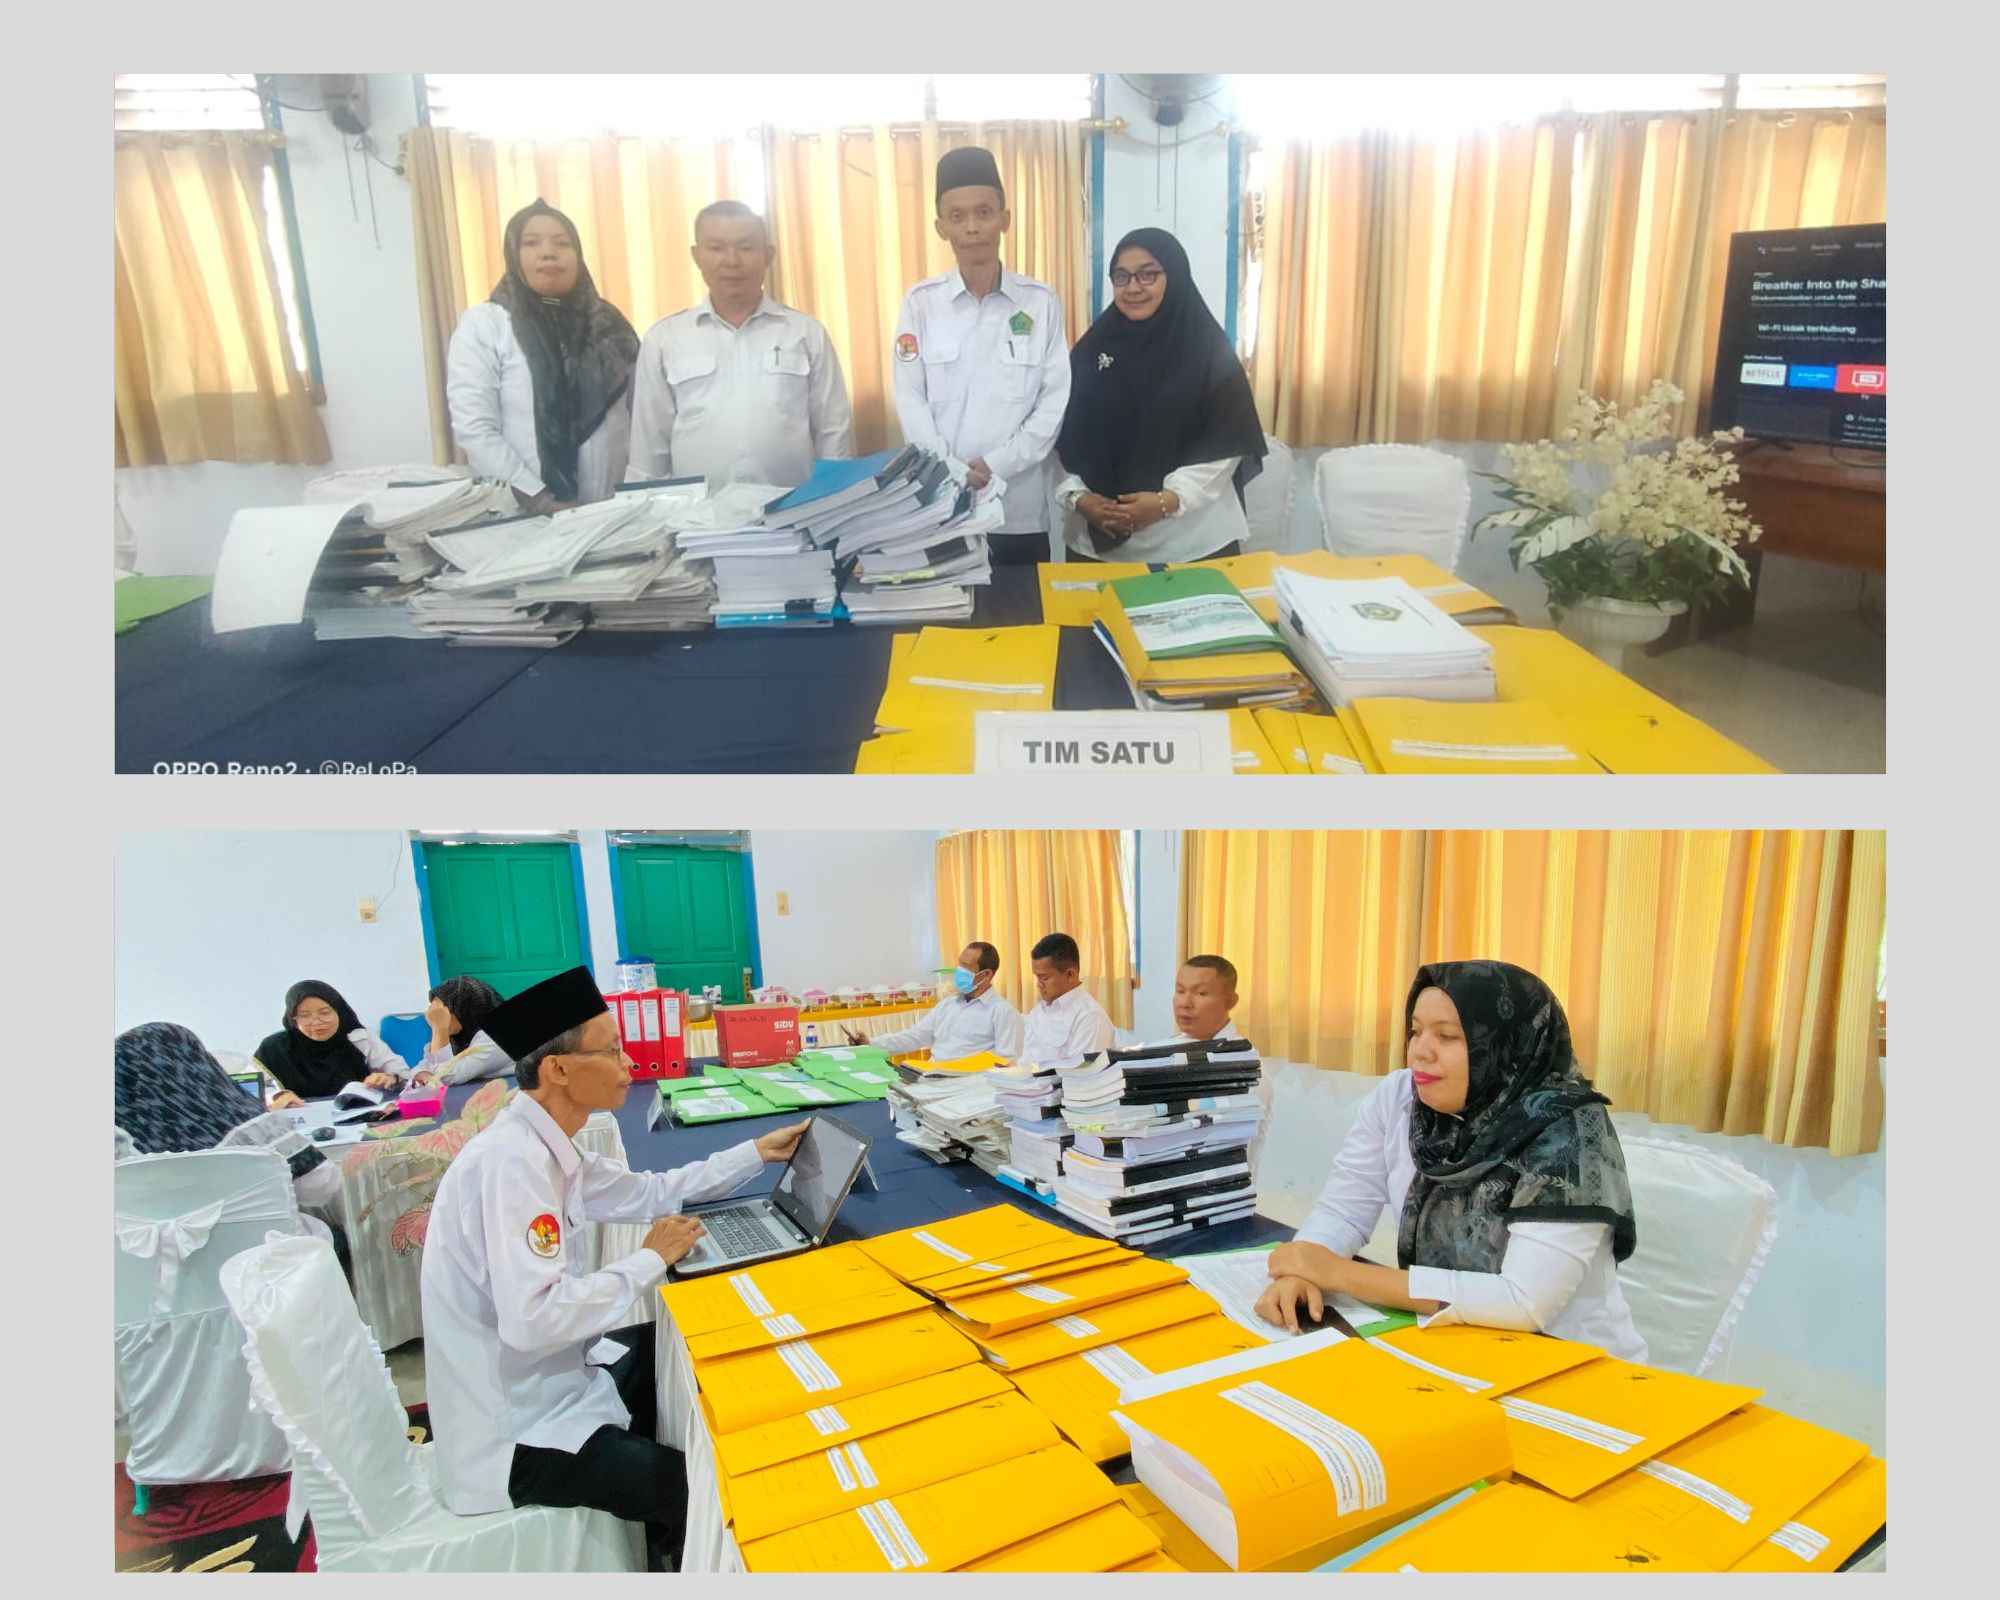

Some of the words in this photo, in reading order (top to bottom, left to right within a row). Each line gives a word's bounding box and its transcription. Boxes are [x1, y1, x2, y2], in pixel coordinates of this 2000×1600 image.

[1753, 280, 1803, 290] Breathe:
[1807, 280, 1832, 290] Into
[1835, 279, 1858, 289] the
[1023, 741, 1079, 764] TIM
[1091, 741, 1175, 764] SATU
